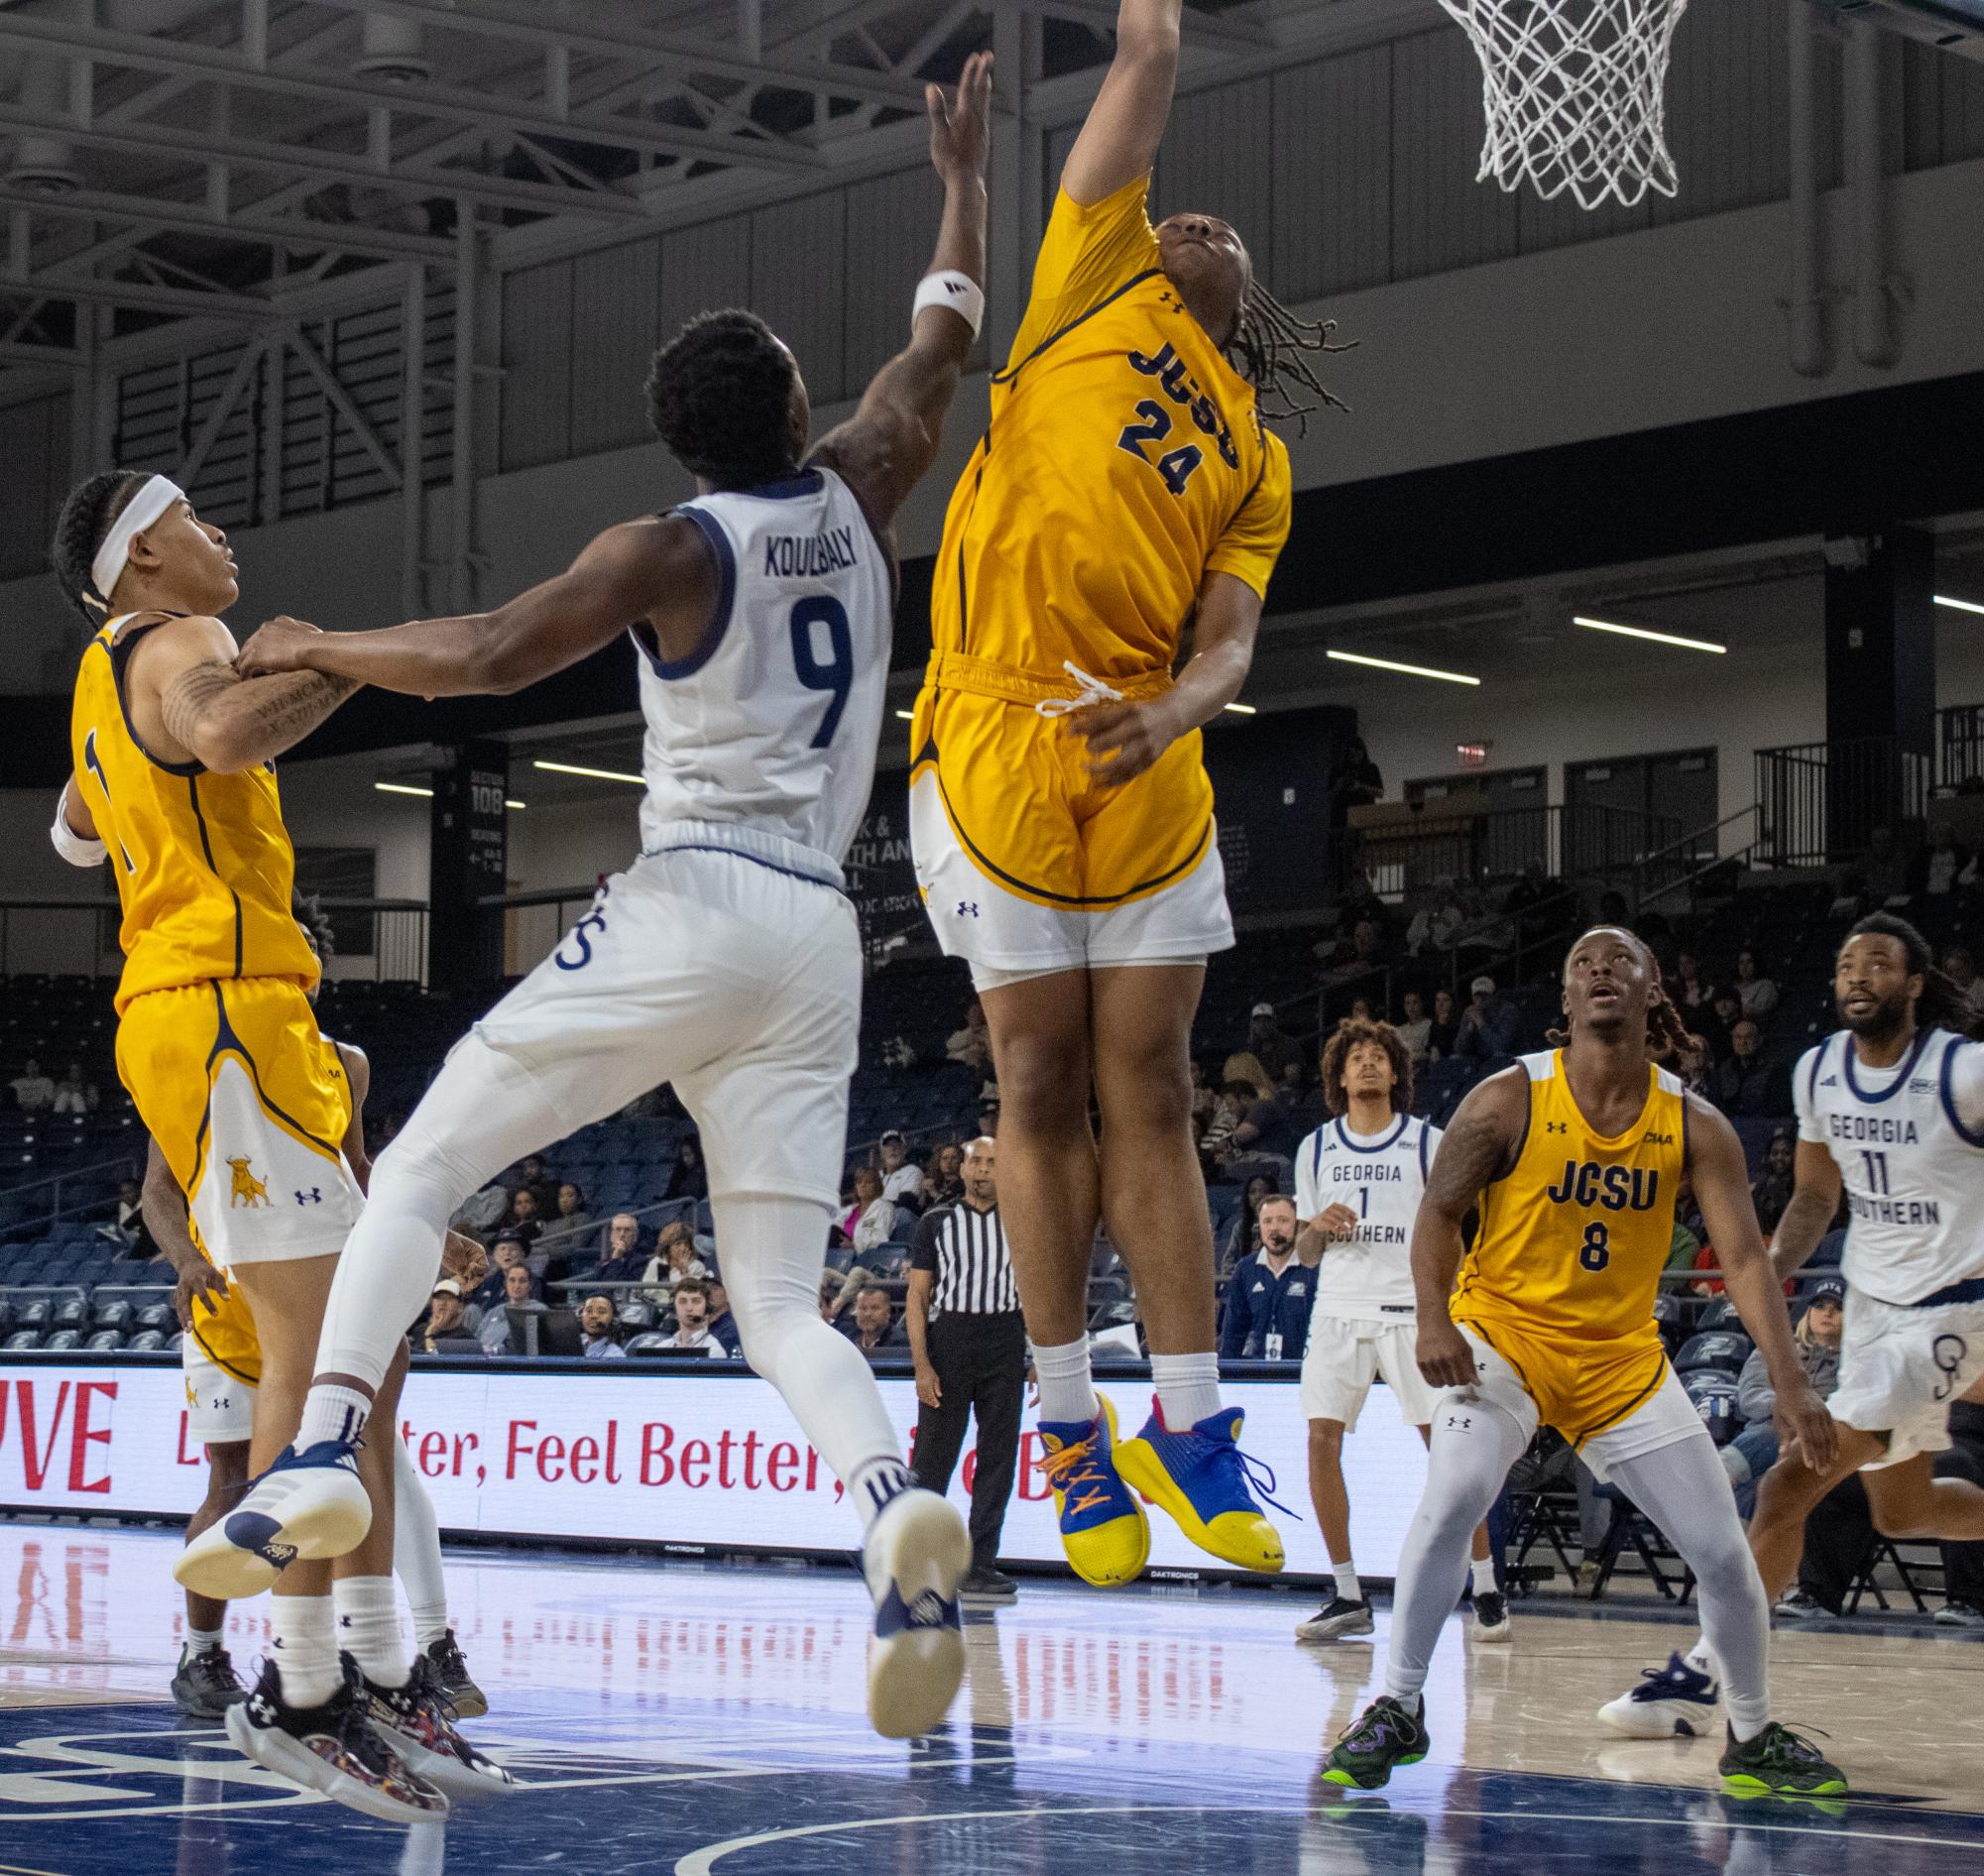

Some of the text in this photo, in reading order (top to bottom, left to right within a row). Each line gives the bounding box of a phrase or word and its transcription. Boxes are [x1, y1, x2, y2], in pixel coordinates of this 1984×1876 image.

[1115, 399, 1204, 497] 24
[790, 595, 854, 748] 9
[84, 726, 136, 876] 1
[471, 785, 504, 816] 108
[1829, 1114, 1920, 1144] GEORGIA
[1333, 1164, 1402, 1182] GEORGIA
[1547, 1159, 1659, 1211] JCSU
[1861, 1150, 1889, 1196] 11
[1359, 1186, 1368, 1220] 1
[1578, 1220, 1610, 1273] 8
[0, 1379, 118, 1493] VE
[402, 1420, 487, 1488] ter,
[506, 1419, 623, 1485] Feel
[640, 1421, 845, 1504] Better,
[1150, 1570, 1199, 1580] DAKTRONICS
